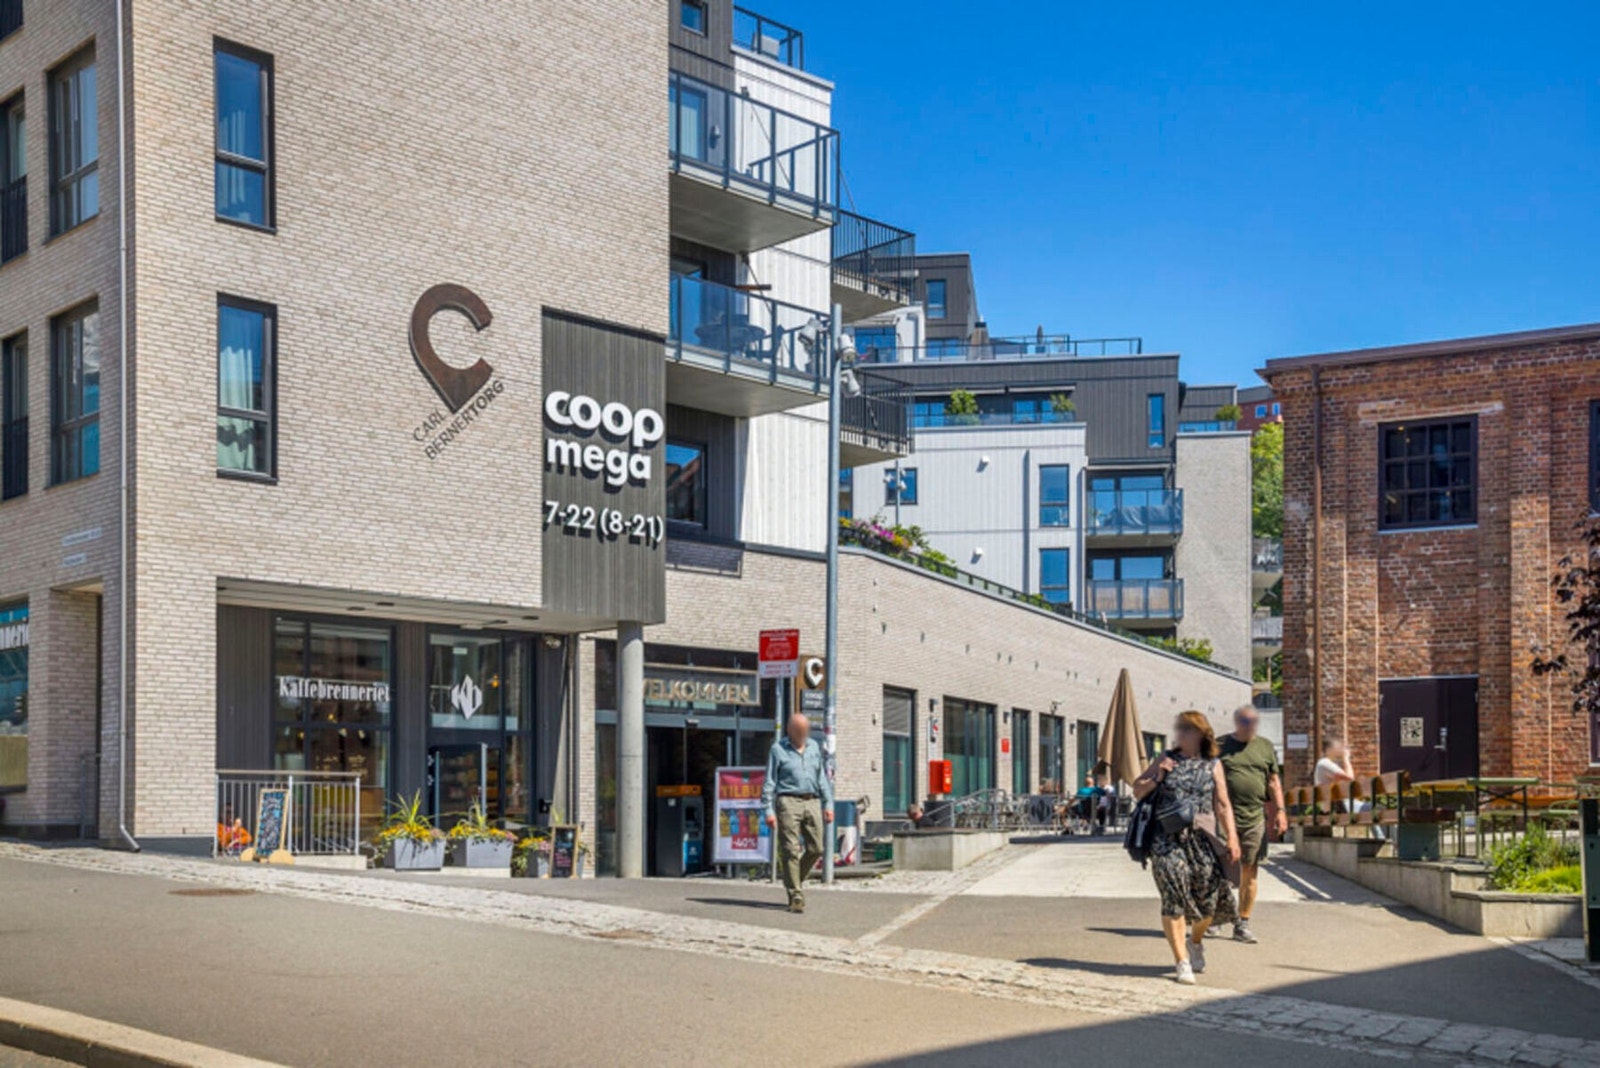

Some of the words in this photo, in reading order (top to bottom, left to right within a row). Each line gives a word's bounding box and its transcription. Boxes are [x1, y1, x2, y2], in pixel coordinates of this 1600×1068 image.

[413, 408, 447, 442] CARL
[545, 390, 665, 448] coop
[546, 437, 652, 486] mega
[545, 500, 596, 531] 7-22
[599, 507, 665, 543] (8-21)
[721, 784, 762, 798] TILBU
